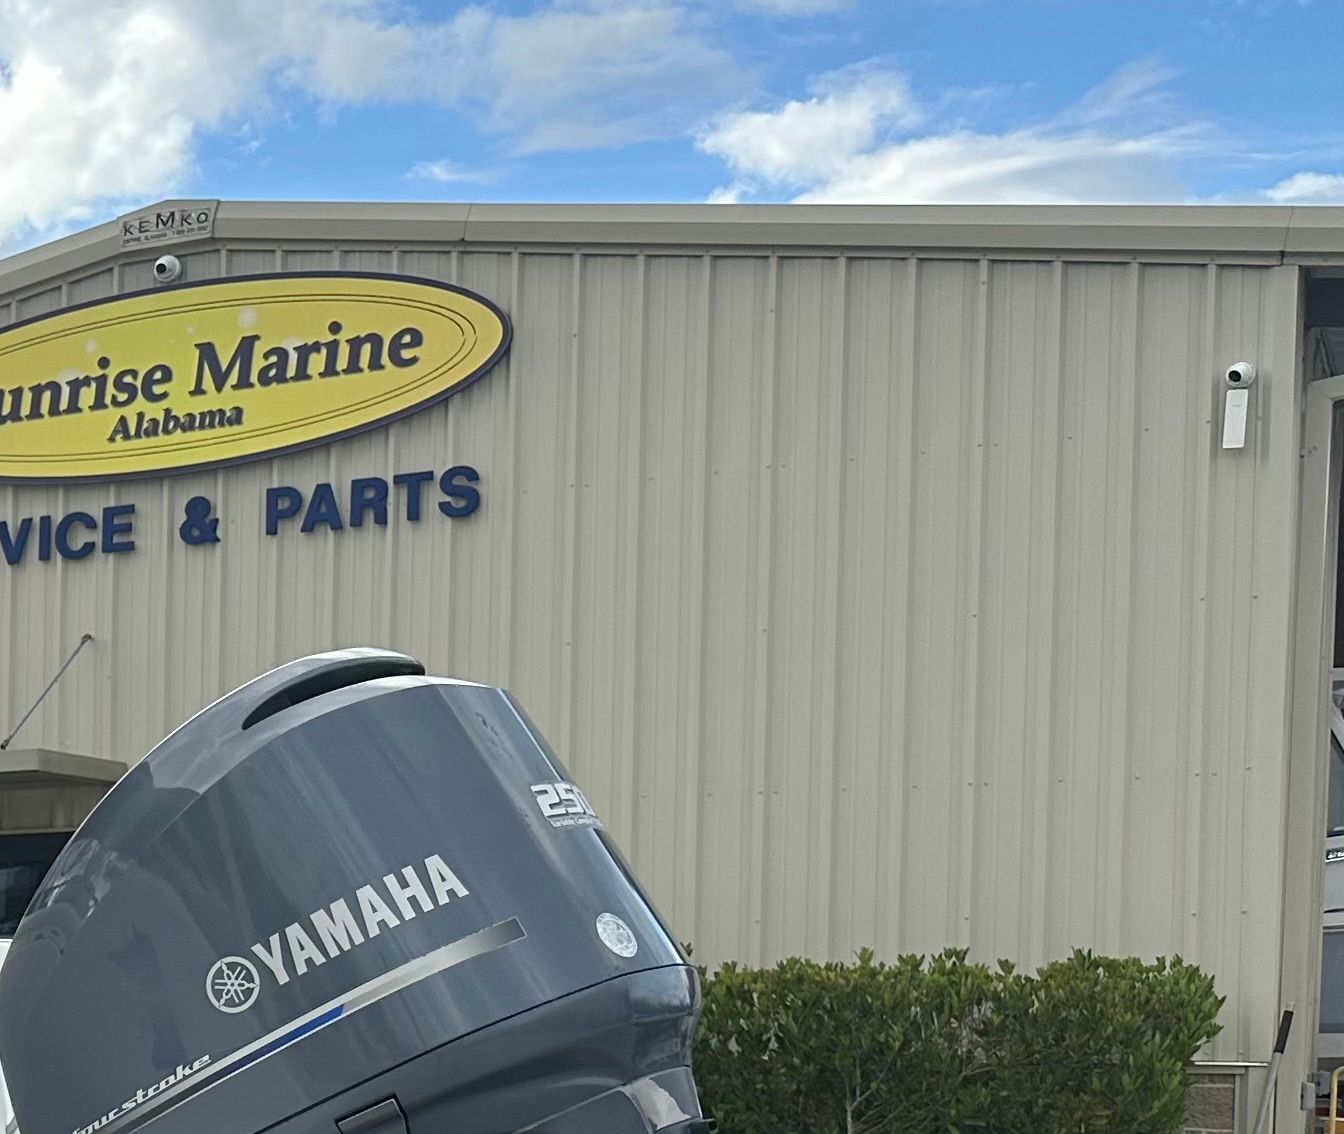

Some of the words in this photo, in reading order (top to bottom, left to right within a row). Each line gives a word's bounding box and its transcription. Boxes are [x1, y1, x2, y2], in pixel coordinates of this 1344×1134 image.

[123, 211, 209, 236] KEMKO
[189, 321, 423, 396] Marine
[108, 403, 243, 442] Alabama
[179, 496, 221, 546] &
[265, 466, 481, 536] PARTS
[250, 854, 470, 986] YAMAHA
